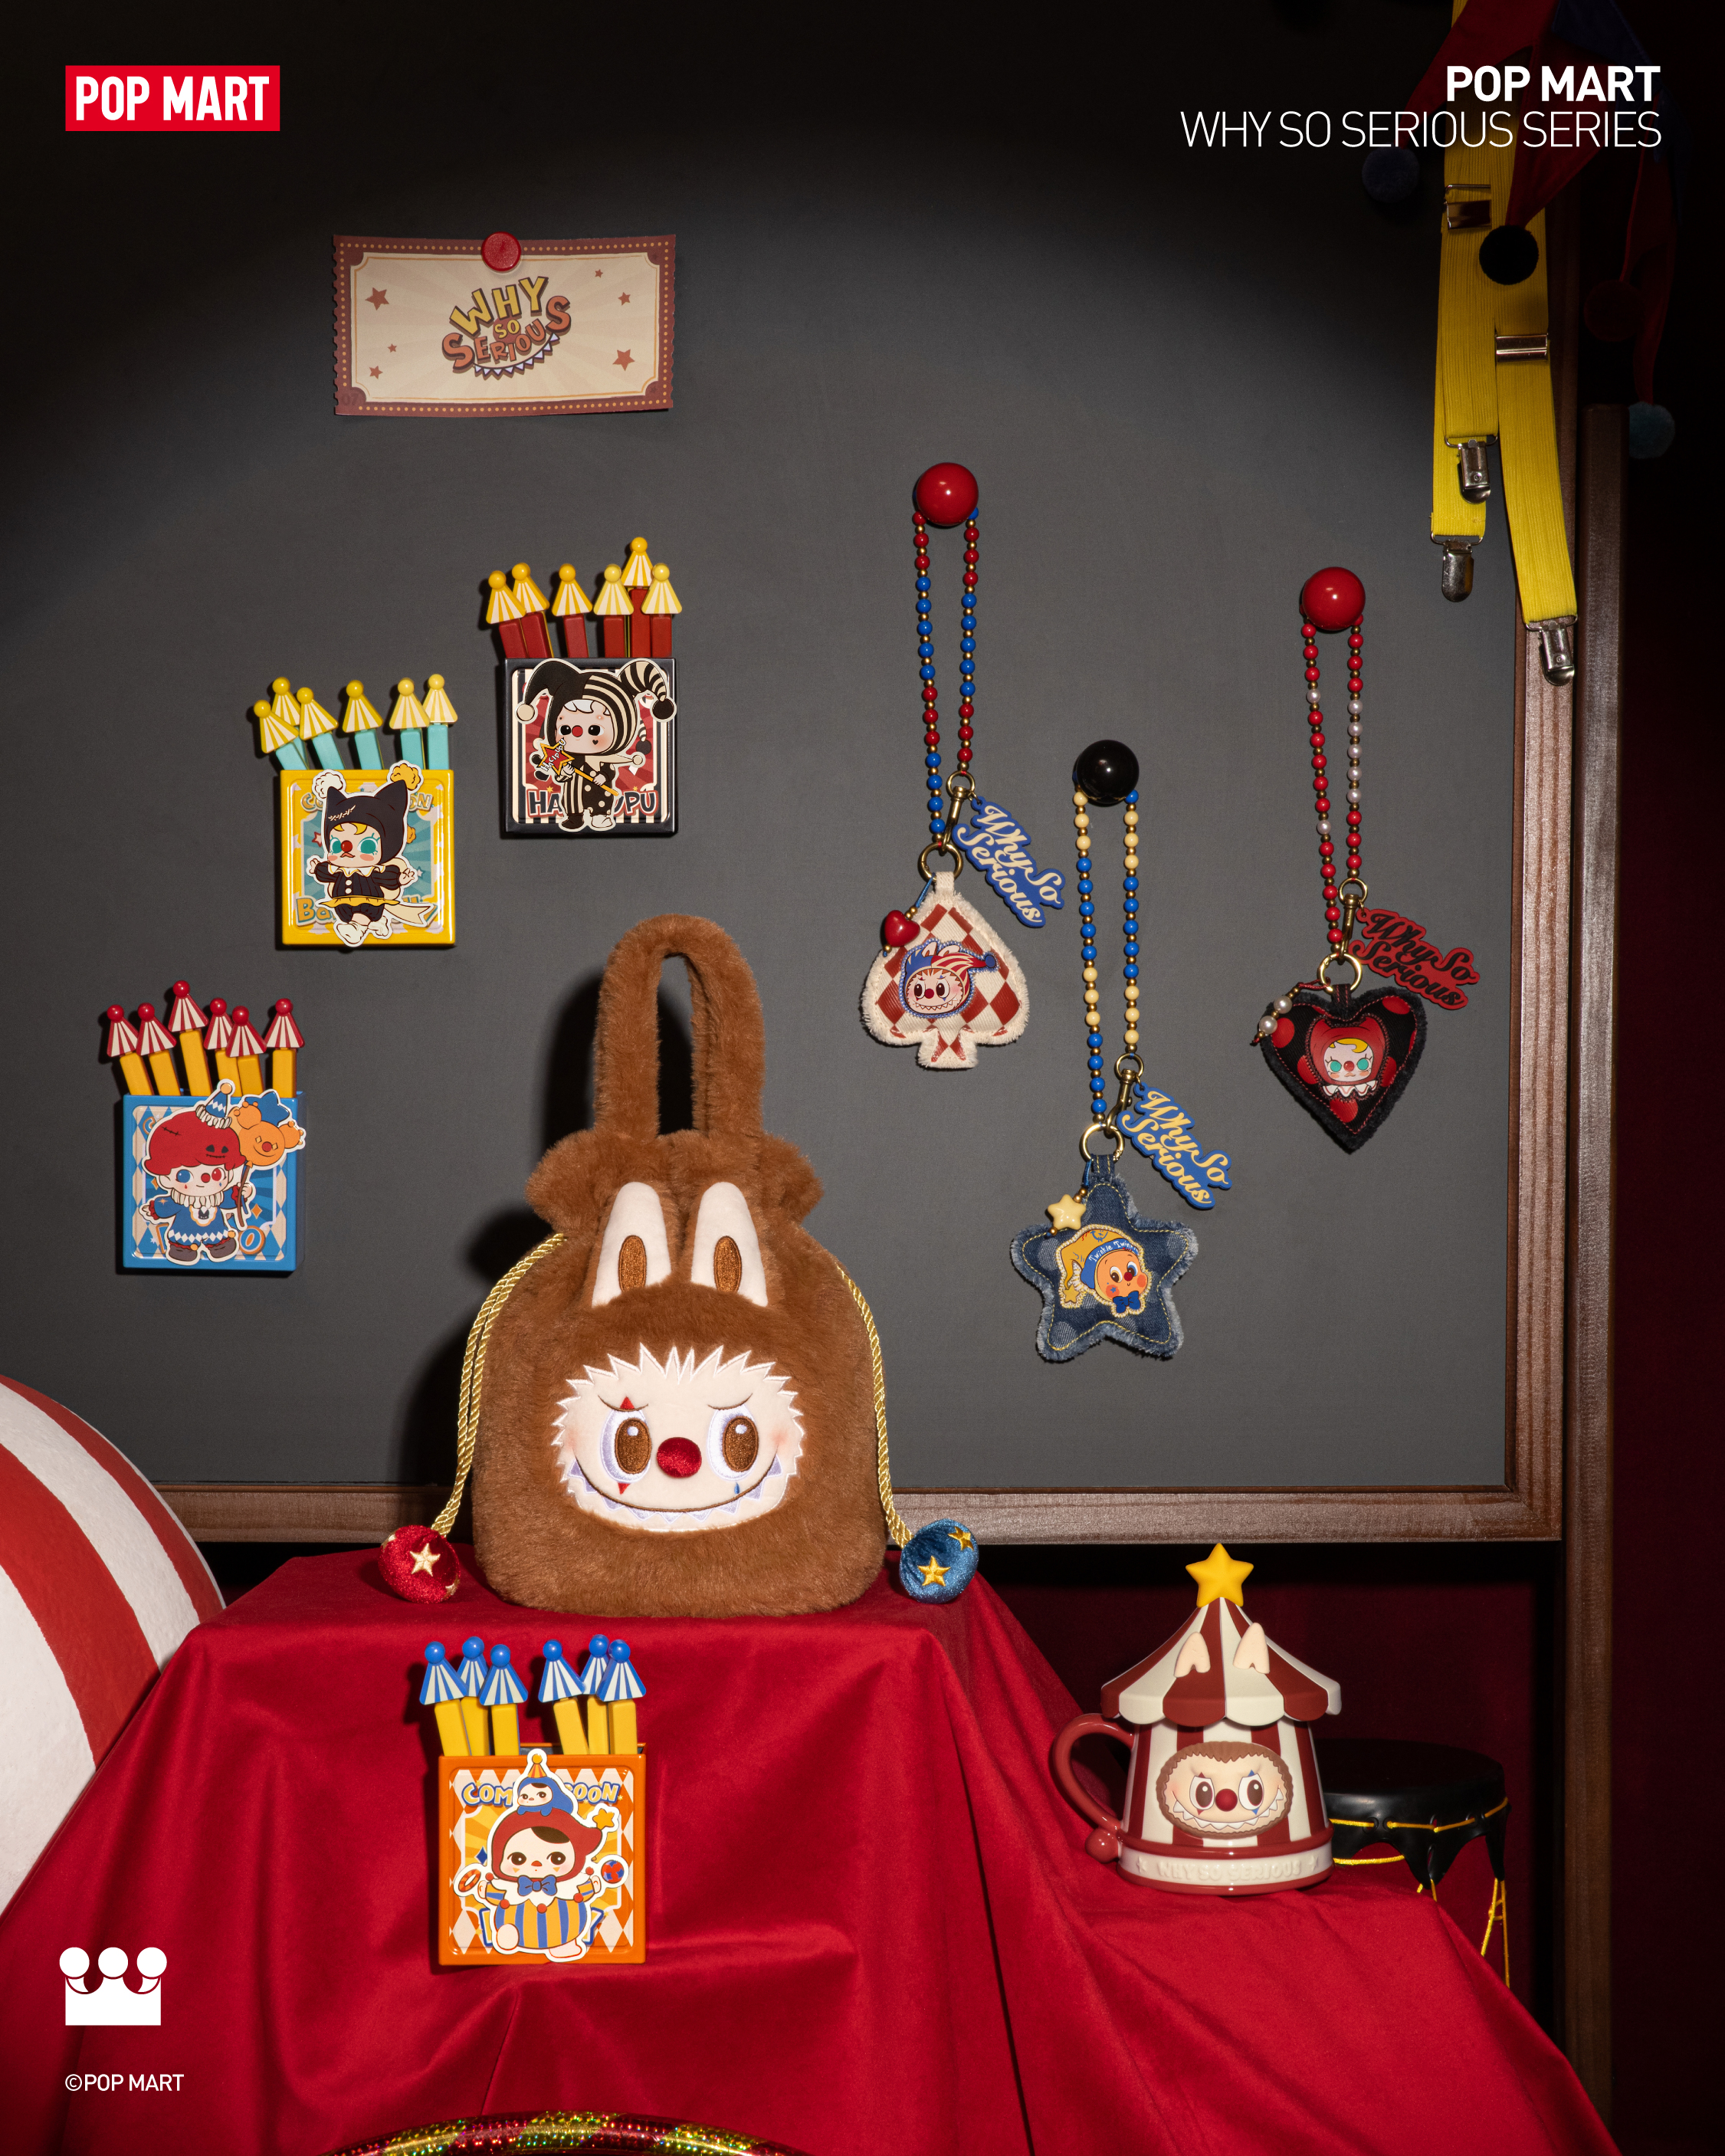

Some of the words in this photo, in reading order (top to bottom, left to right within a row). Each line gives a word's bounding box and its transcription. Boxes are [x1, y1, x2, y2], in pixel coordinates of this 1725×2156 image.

[442, 295, 572, 374] SERIOUS
[449, 276, 549, 337] WHY
[494, 319, 520, 339] SO
[957, 827, 1043, 923] Serious
[977, 806, 1033, 867] Why
[1025, 867, 1062, 904] So
[1352, 941, 1465, 1006] Serious
[1366, 913, 1435, 966] Why
[1430, 952, 1477, 980] So
[1121, 1114, 1212, 1204] Serious
[1140, 1091, 1199, 1153] Why
[1191, 1150, 1229, 1185] So
[1088, 1245, 1113, 1262] Twinkle
[565, 1780, 621, 1804] OON
[1157, 1861, 1195, 1879] WHY
[1198, 1863, 1223, 1881] SO
[1228, 1859, 1303, 1881] SERIOUS
